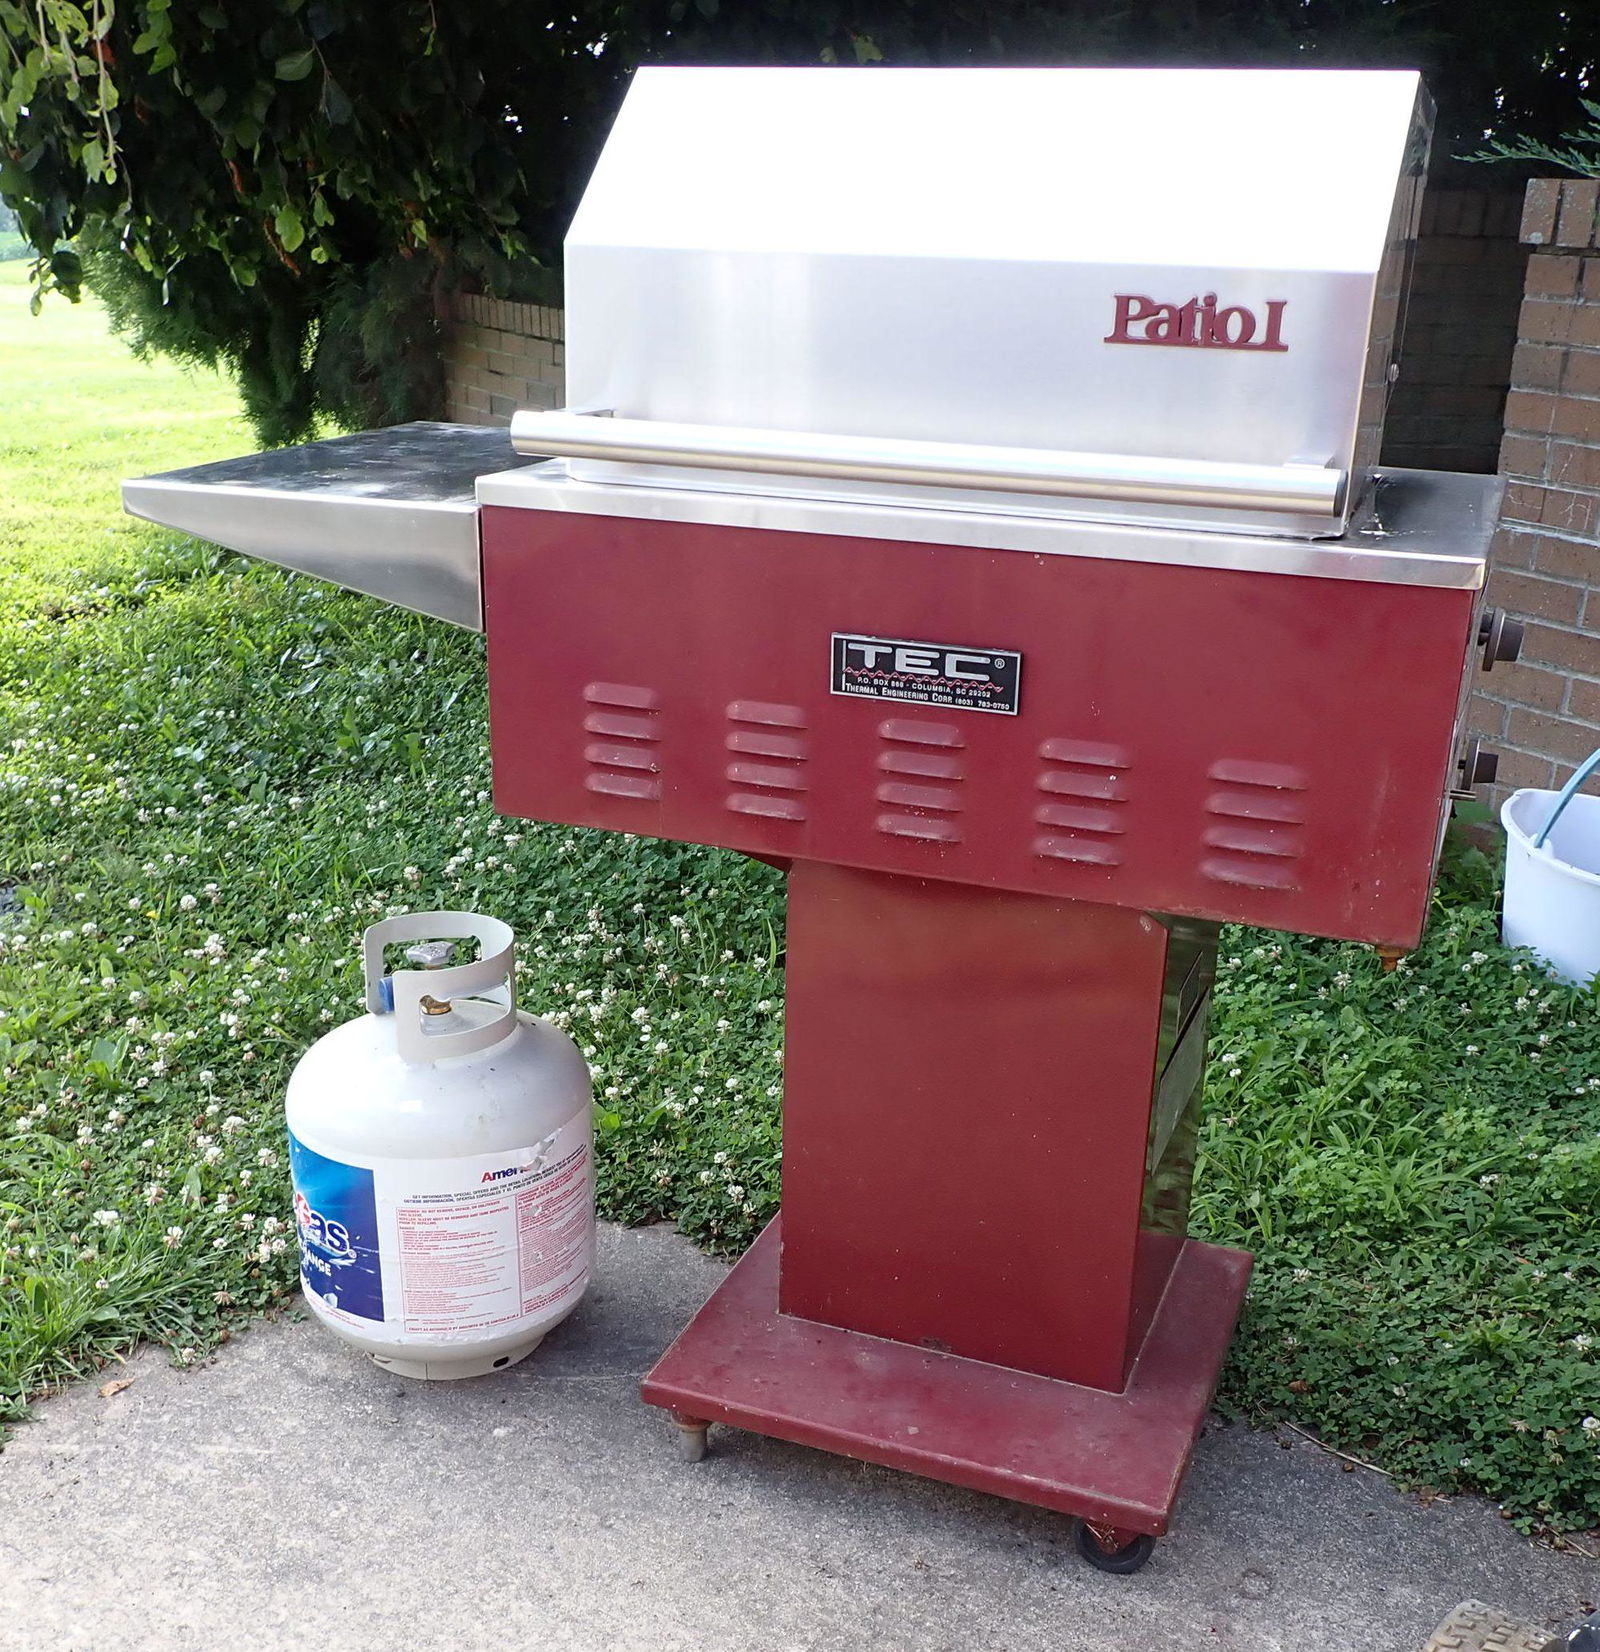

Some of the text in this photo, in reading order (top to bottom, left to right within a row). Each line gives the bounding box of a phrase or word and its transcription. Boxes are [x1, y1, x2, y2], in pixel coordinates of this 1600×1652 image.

[1104, 291, 1257, 348] Patio
[873, 678, 889, 686] BOX
[911, 683, 954, 694] COLUMBIA,
